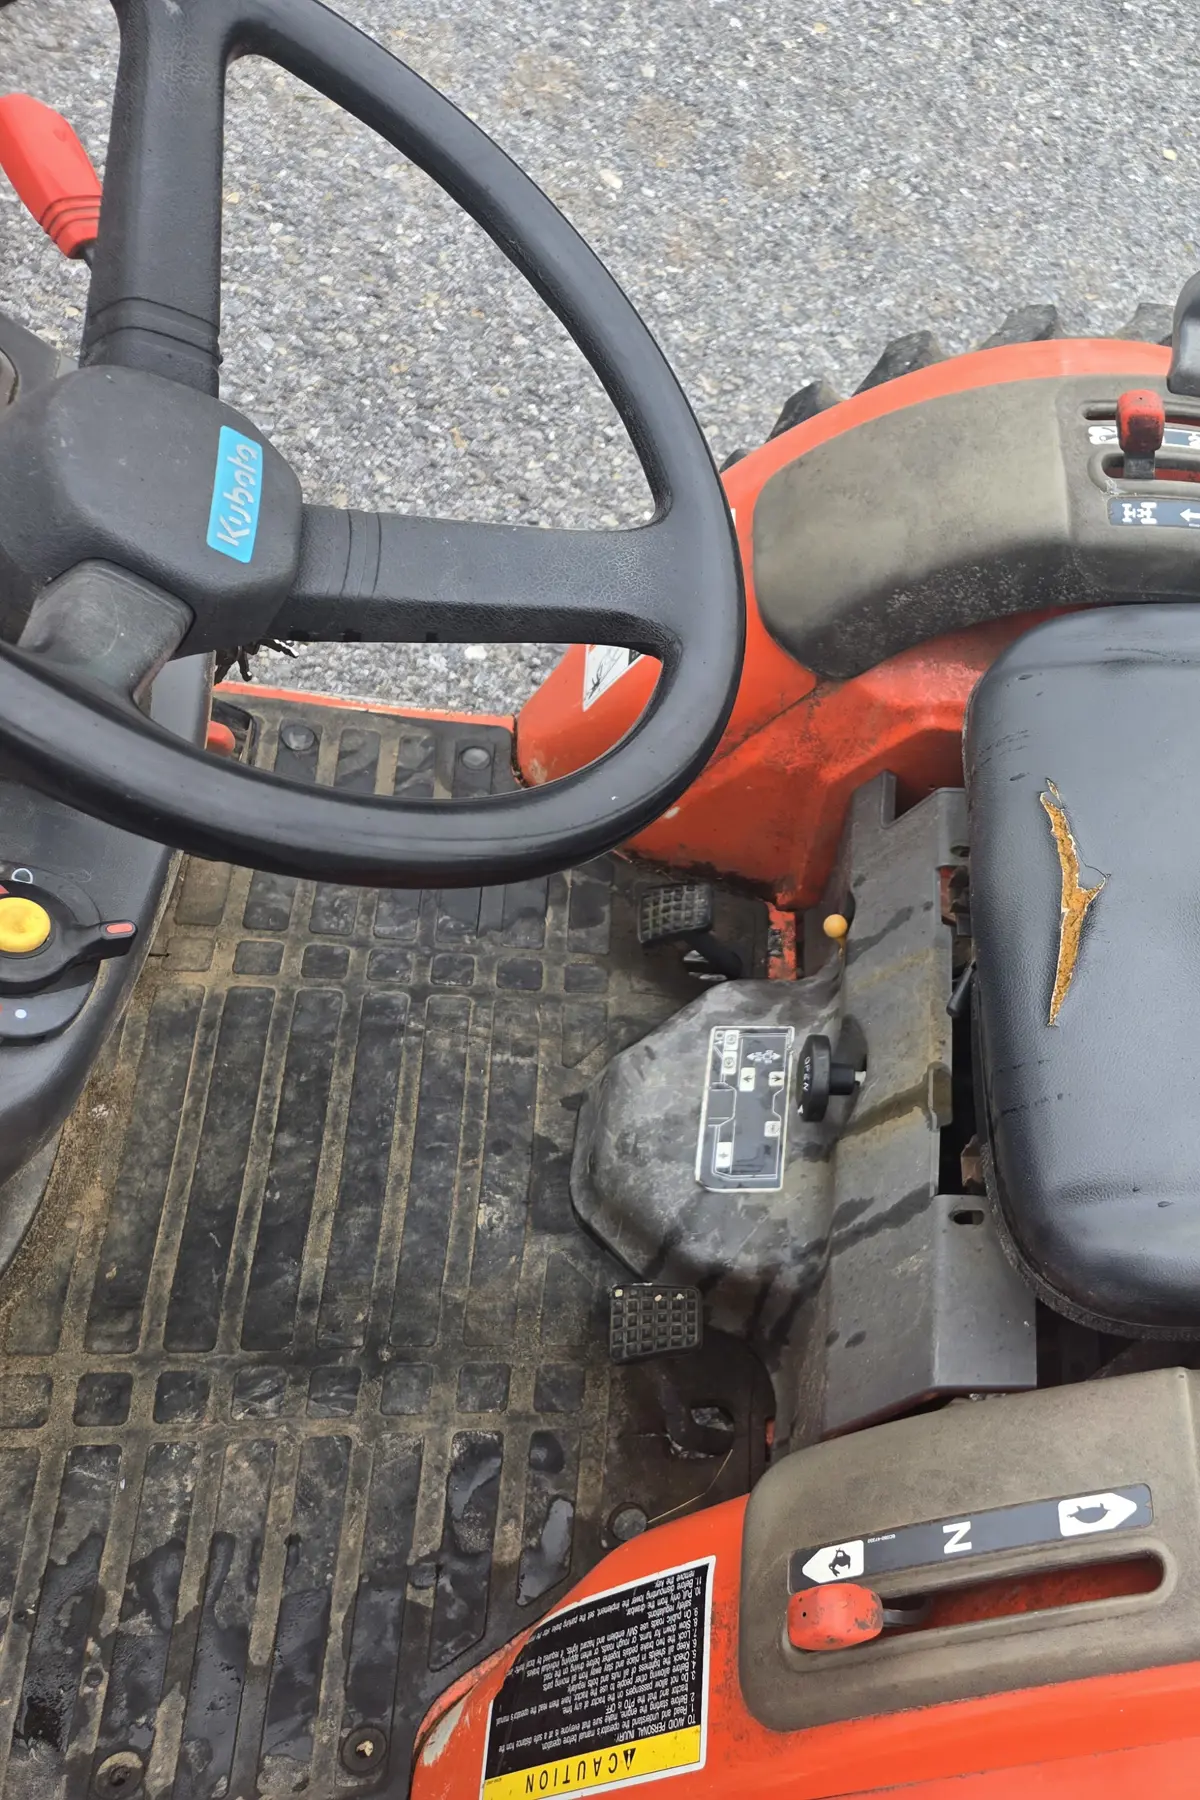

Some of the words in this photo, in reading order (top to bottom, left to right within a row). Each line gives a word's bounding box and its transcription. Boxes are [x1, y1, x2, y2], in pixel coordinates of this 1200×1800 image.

[216, 443, 258, 547] Kubota
[943, 1520, 973, 1554] N
[525, 1752, 618, 1794] CAUTION
